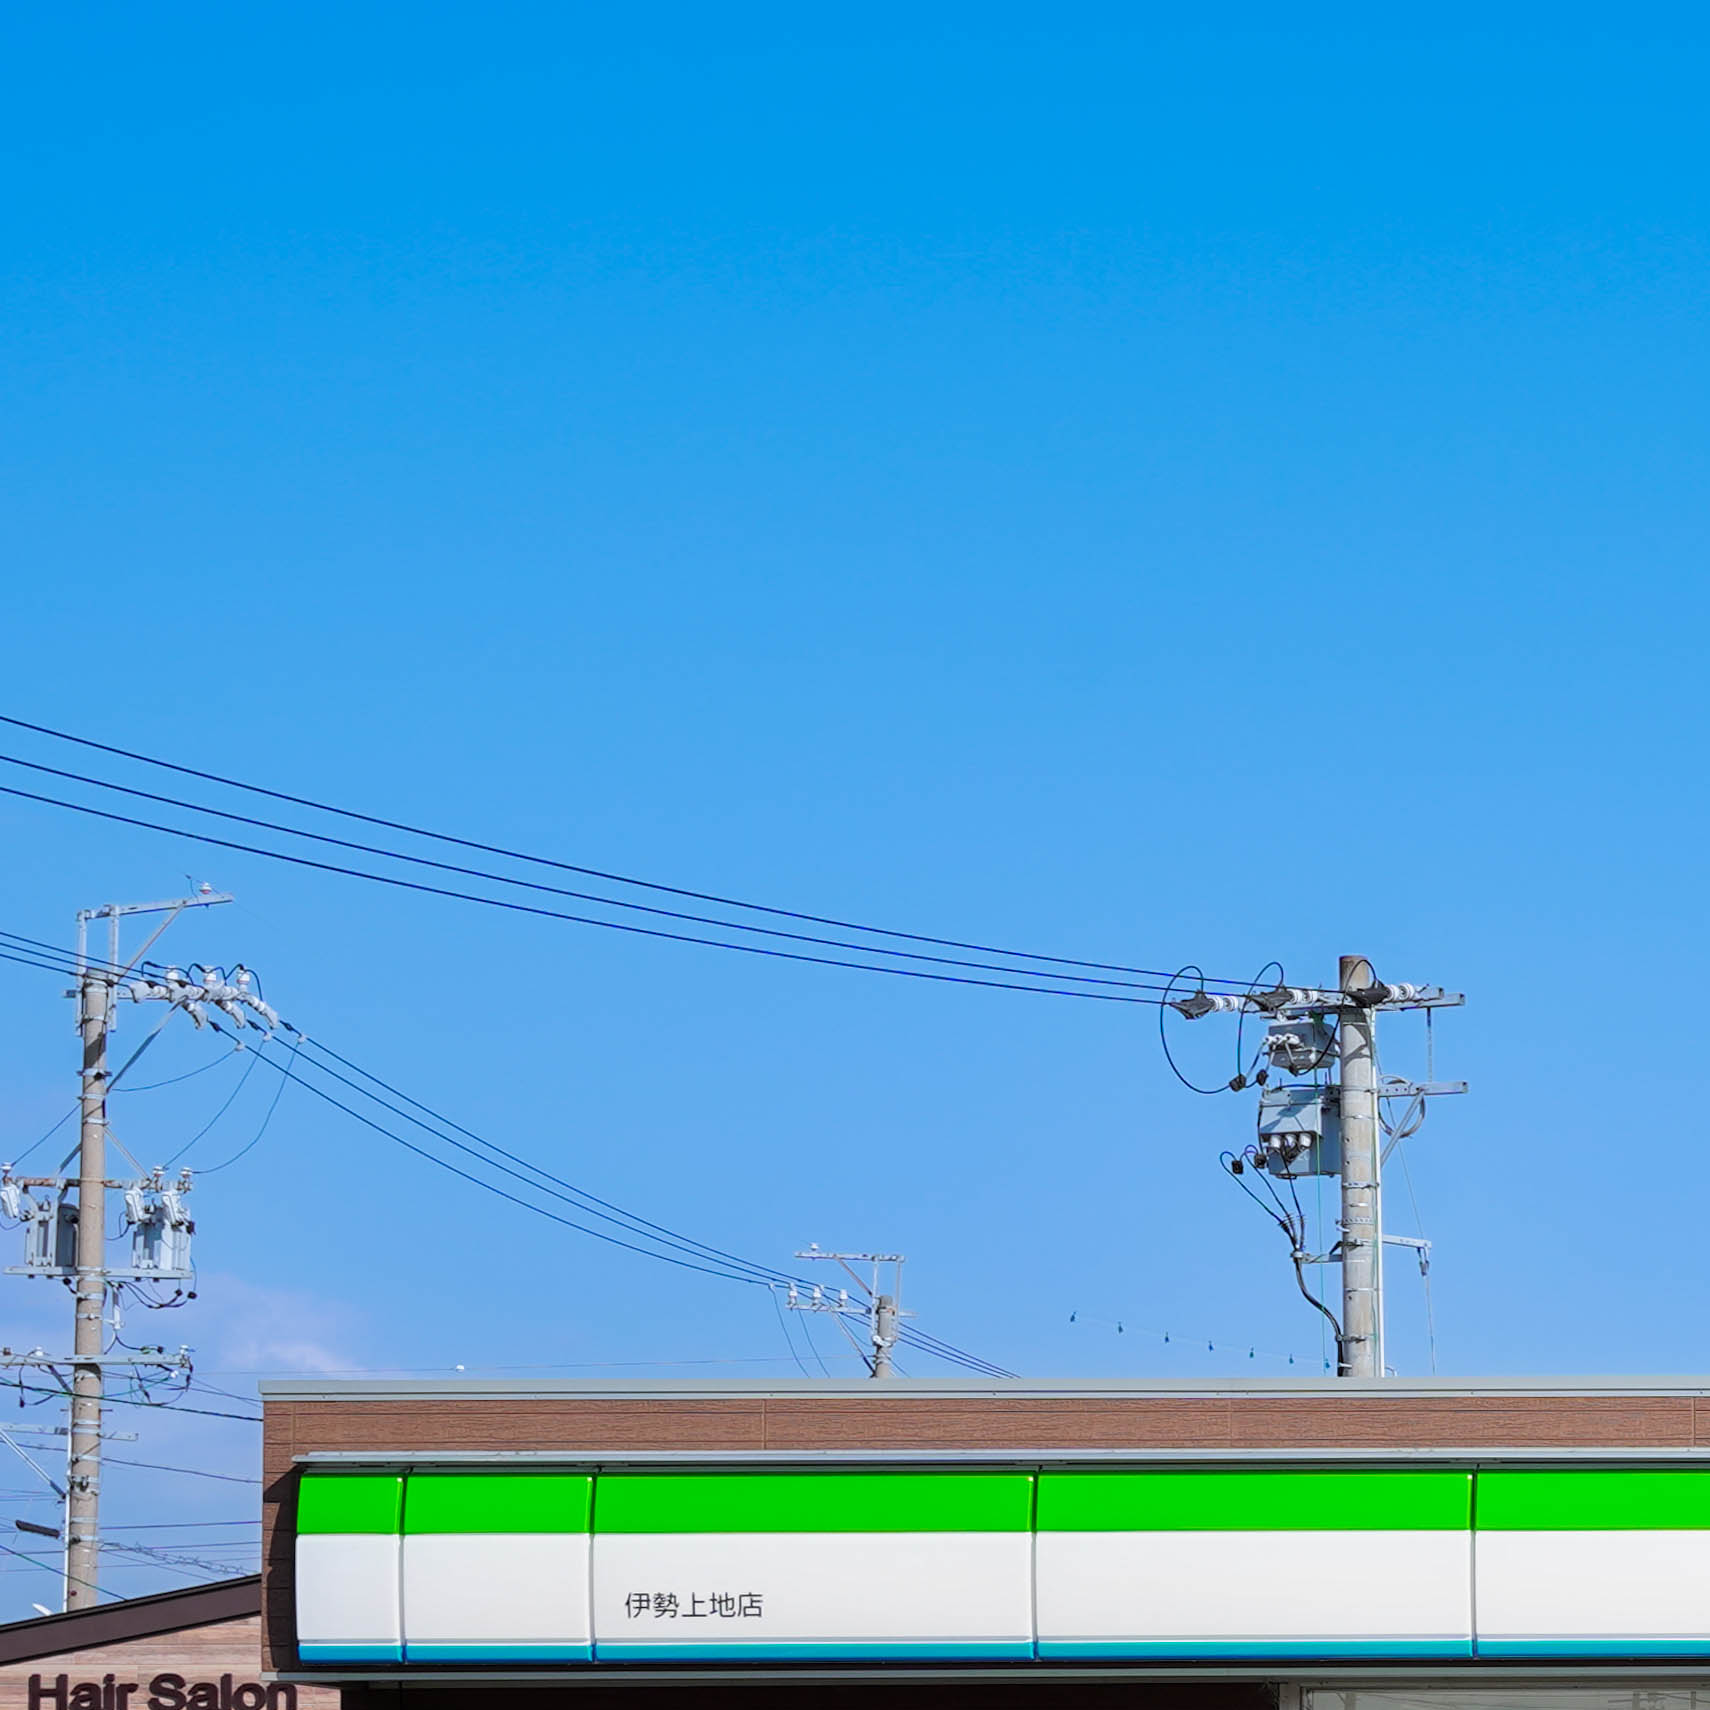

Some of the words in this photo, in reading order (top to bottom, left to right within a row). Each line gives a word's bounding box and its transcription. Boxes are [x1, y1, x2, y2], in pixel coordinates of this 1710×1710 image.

[625, 1593, 763, 1618] 伊勢上地店
